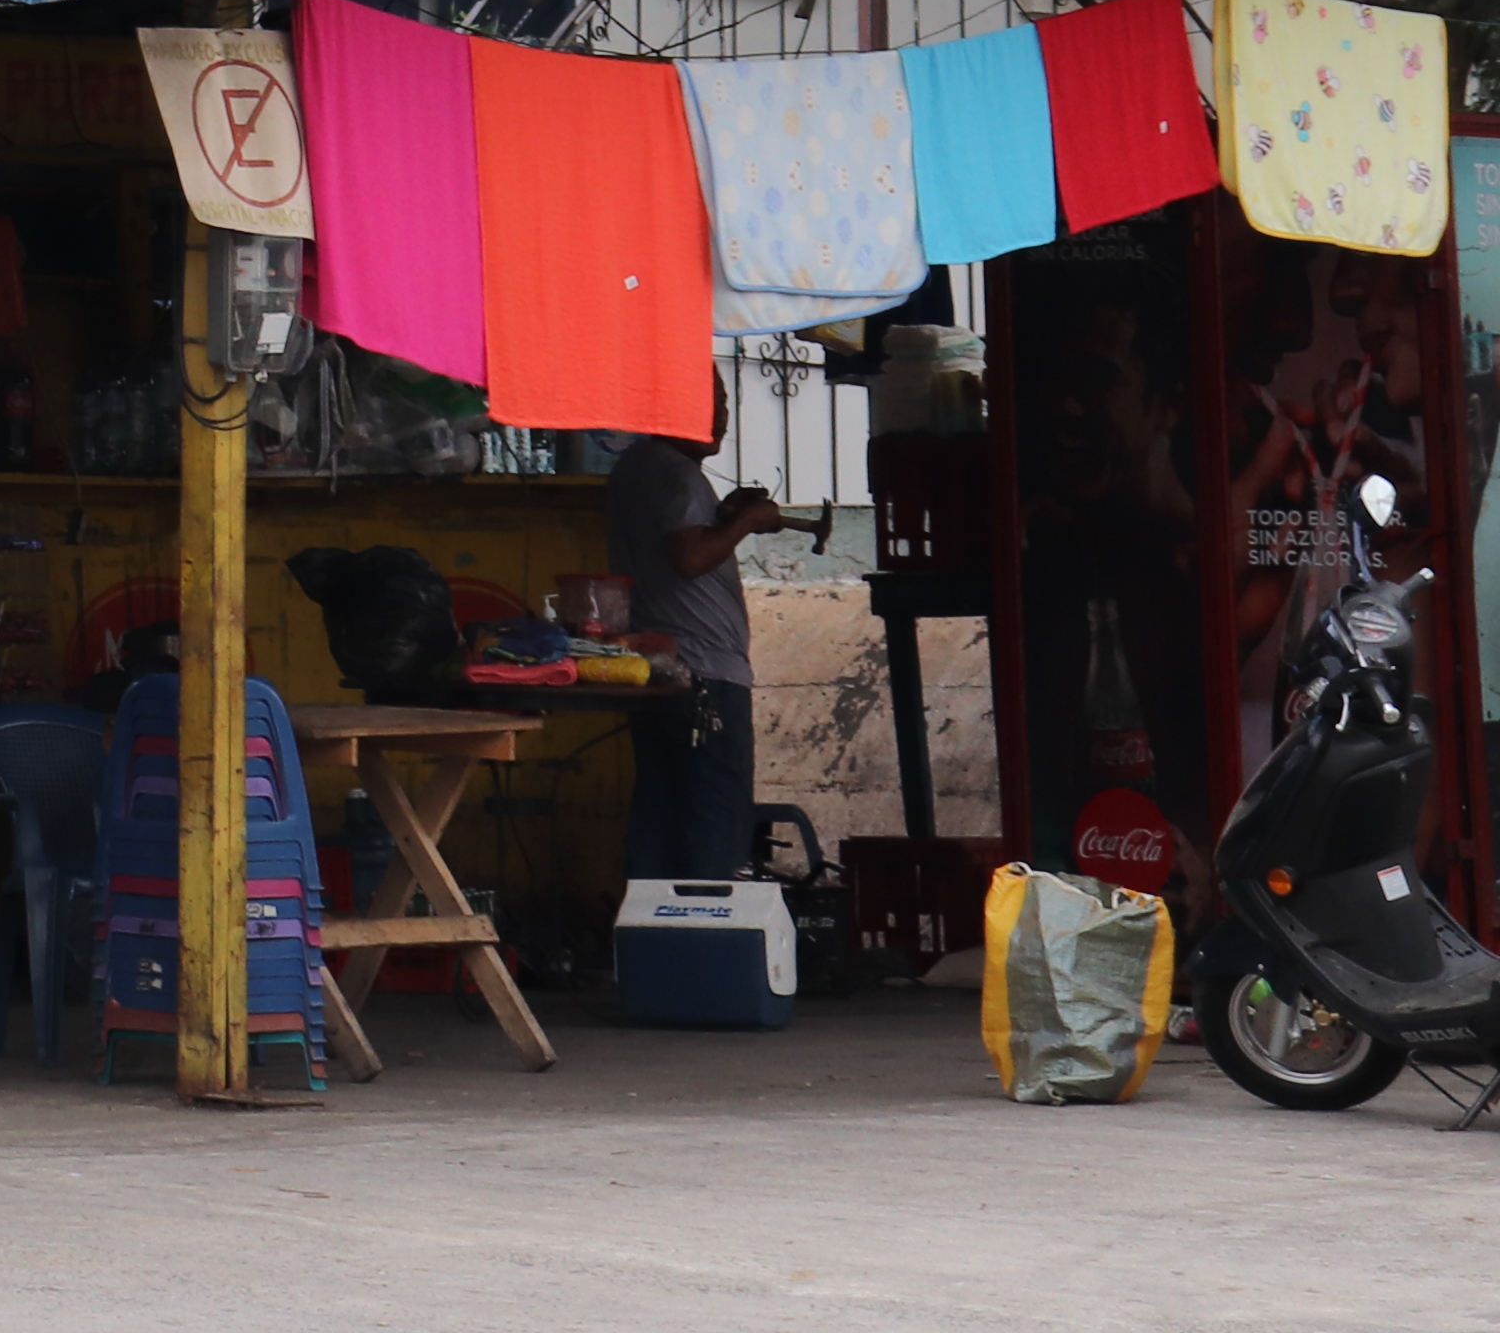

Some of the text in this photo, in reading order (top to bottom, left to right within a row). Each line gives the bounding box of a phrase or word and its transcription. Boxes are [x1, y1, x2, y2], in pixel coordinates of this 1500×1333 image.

[1246, 509, 1302, 527] TODO
[1307, 511, 1329, 526] EL
[1247, 529, 1351, 547] SIN AZUCA
[1248, 549, 1280, 566] SIN
[1079, 826, 1167, 862] Coca-Cola
